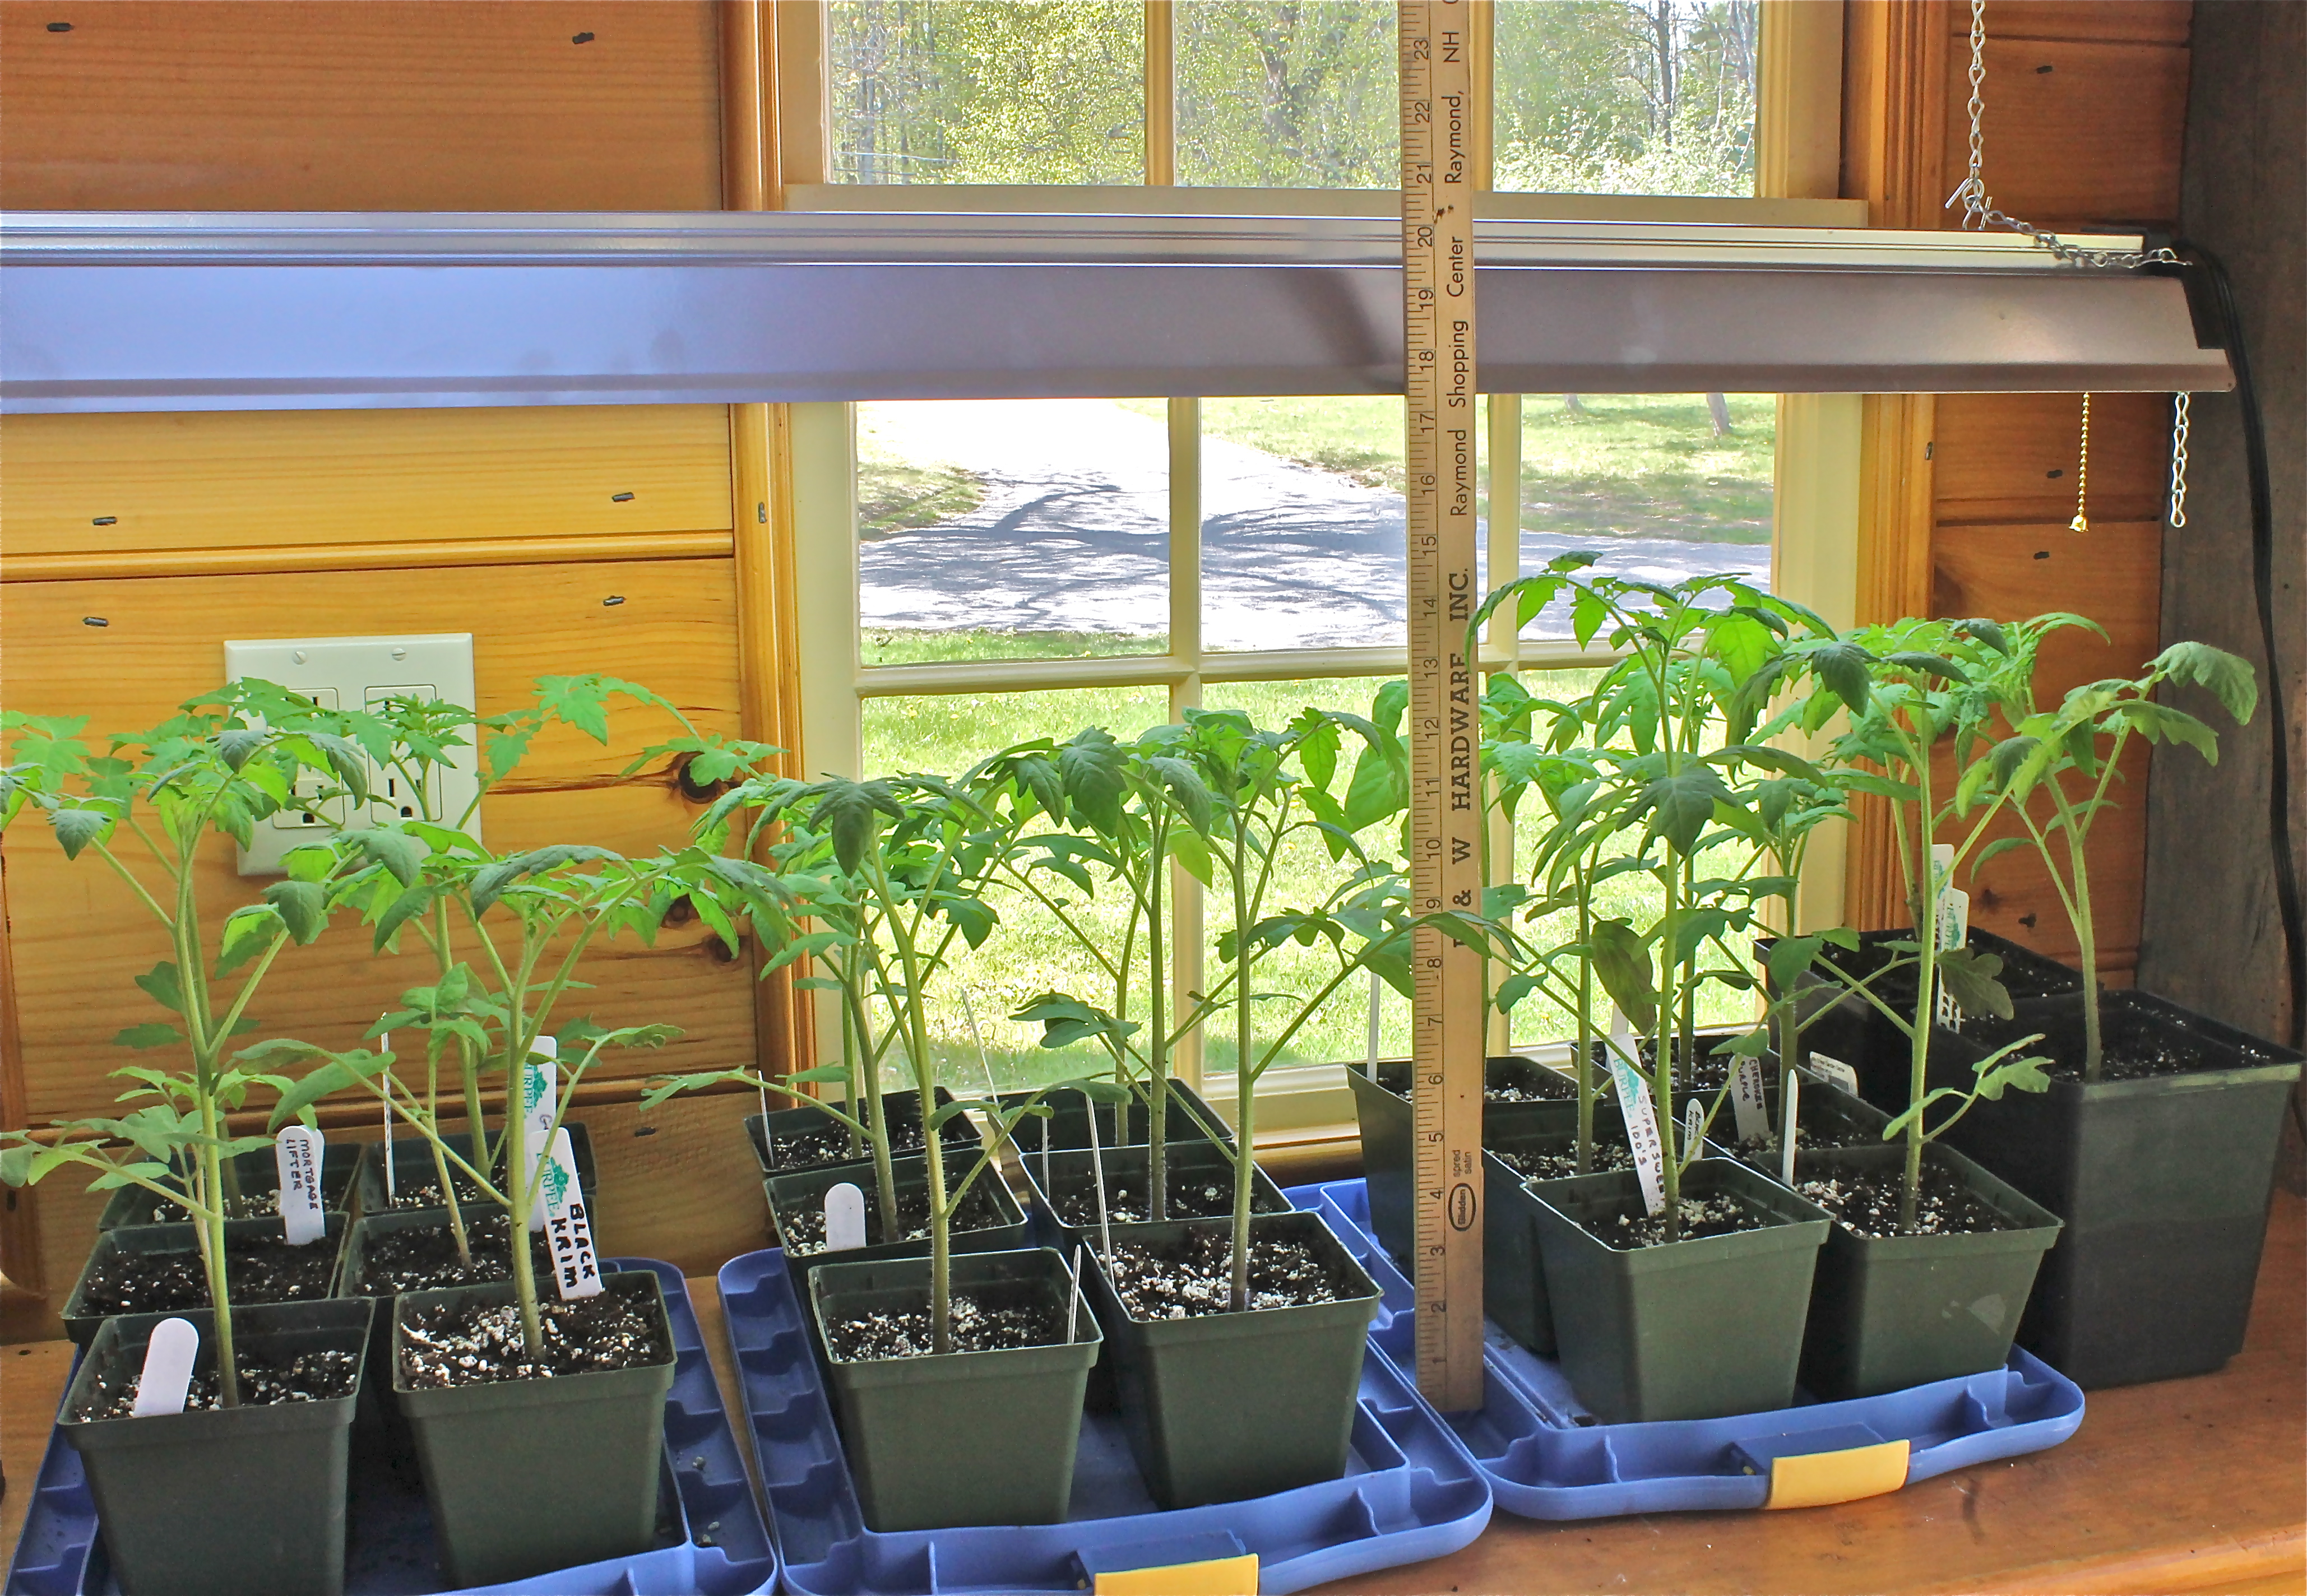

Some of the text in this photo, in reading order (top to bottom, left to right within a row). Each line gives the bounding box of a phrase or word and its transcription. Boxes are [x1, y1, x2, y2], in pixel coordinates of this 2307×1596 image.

[1414, 39, 1429, 59] 23
[1414, 102, 1430, 123] 22
[1416, 164, 1432, 183] 21
[1417, 227, 1433, 247] 20
[1418, 289, 1433, 309] 19
[1419, 351, 1434, 372] 18
[1420, 413, 1435, 433] 17
[1441, 31, 1471, 906] & W HARDWARE INC. Raymond Shopping Center Raymond, NH
[1421, 475, 1435, 495] 16
[1422, 536, 1437, 555] 15
[1423, 598, 1437, 616] 14
[1424, 658, 1438, 678] 13
[1424, 719, 1439, 739] 12
[1425, 779, 1440, 796] 11
[1426, 840, 1440, 859] 10
[1426, 899, 1440, 909] 9
[1427, 958, 1442, 968] 8
[1428, 1018, 1443, 1026] 7
[524, 1065, 533, 1113] URPEE
[1429, 1075, 1443, 1084] 6
[1613, 1059, 1636, 1112] BURPEE
[1638, 1096, 1657, 1148] SUPER
[1429, 1133, 1443, 1142] 5
[286, 1139, 302, 1190] LIFTER
[1451, 1149, 1464, 1178] spred
[1462, 1152, 1472, 1175] satin
[300, 1139, 318, 1209] MORTGAGE
[1430, 1190, 1444, 1199] 4
[569, 1203, 595, 1279] BLACK
[1430, 1246, 1445, 1255] 3
[551, 1218, 579, 1288] KRIM
[1431, 1303, 1446, 1312] 2
